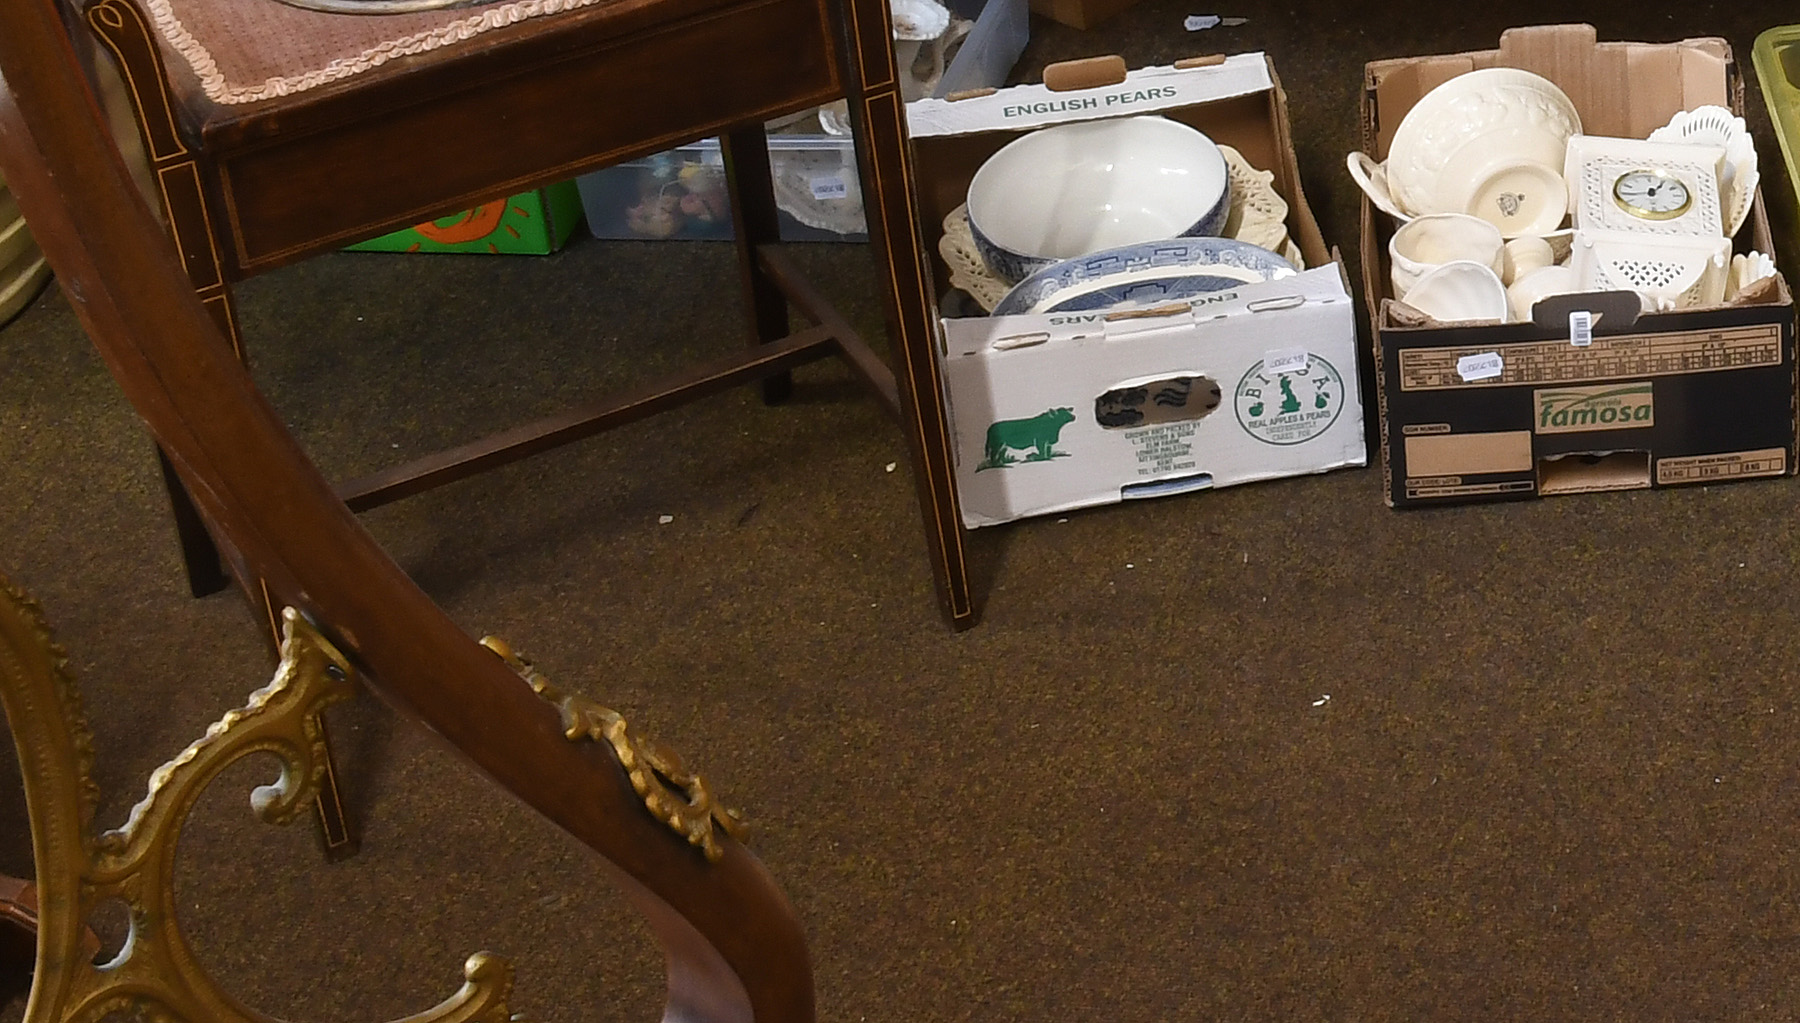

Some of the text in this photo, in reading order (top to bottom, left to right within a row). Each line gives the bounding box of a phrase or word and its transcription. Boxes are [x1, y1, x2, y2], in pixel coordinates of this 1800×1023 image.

[1003, 86, 1177, 118] ENGLISH PEARS
[1050, 315, 1099, 326] ARS
[1248, 419, 1267, 429] REAL
[1269, 414, 1299, 426] APPLES
[1306, 410, 1332, 421] PEARS
[1541, 403, 1651, 427] famosa
